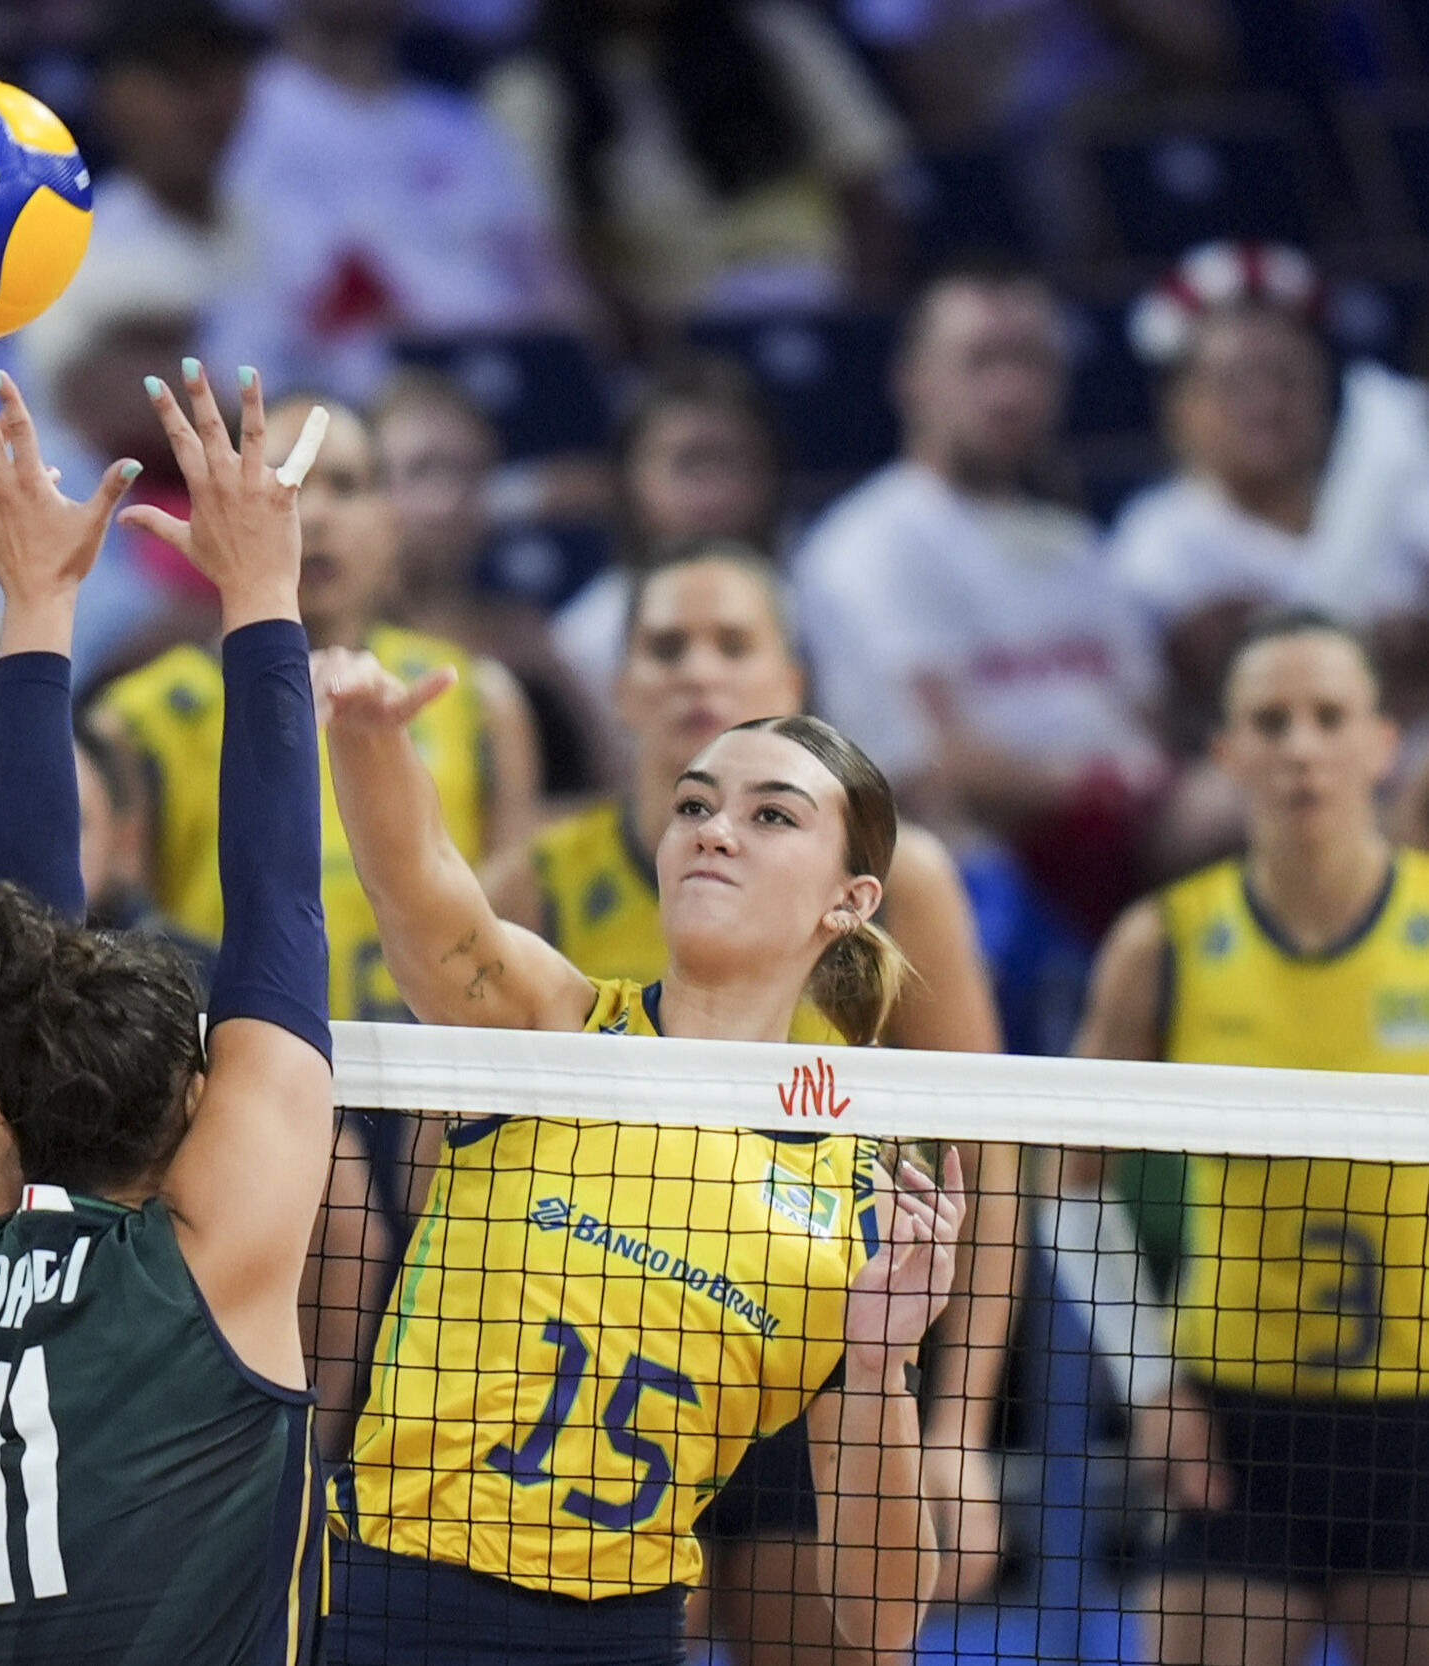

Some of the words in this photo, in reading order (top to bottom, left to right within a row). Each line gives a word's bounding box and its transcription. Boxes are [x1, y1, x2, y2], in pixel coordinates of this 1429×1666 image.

[777, 1056, 852, 1119] VNL
[571, 1213, 670, 1273] BANCO
[668, 1258, 709, 1291] DO
[706, 1271, 781, 1342] BRASIL
[1296, 1222, 1379, 1372] 3
[481, 1315, 702, 1531] 15
